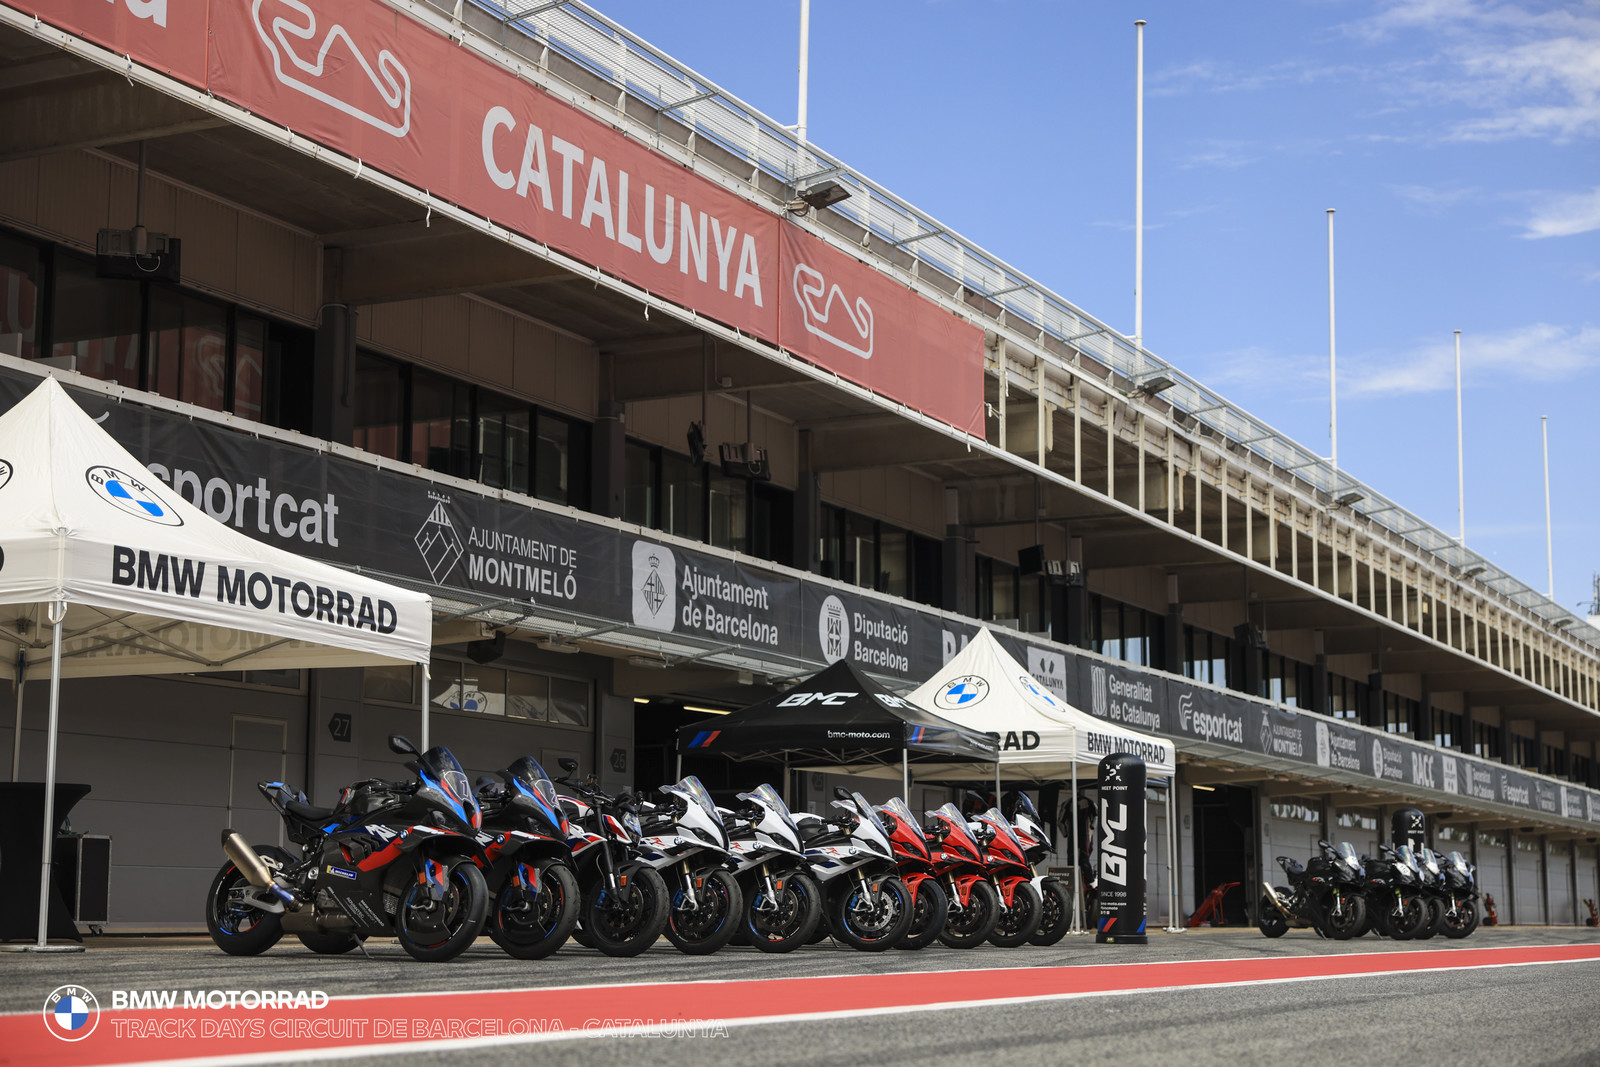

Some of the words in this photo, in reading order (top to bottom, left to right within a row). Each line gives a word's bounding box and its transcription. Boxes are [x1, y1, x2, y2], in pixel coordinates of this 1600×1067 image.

[481, 104, 764, 309] CATALUNYA
[468, 526, 557, 563] AJUNTAMENT
[560, 547, 577, 568] DE
[112, 544, 206, 598] BMW
[216, 565, 398, 635] MOTORRAD
[469, 553, 577, 600] MONTMELÓ
[682, 564, 769, 610] Ajuntament
[682, 599, 702, 629] de
[705, 604, 778, 646] Barcelona
[853, 612, 908, 645] Diputació
[853, 640, 909, 673] Barcelona
[1108, 674, 1153, 703] Generalitat
[333, 717, 350, 737] 27
[1110, 699, 1121, 720] de
[1122, 702, 1160, 732] Catalunya
[1193, 710, 1243, 744] esportcat
[827, 730, 891, 739] bmc-moto.com
[1087, 731, 1112, 755] BMW
[1114, 736, 1166, 764] MOTORRAD
[1411, 750, 1435, 788] RACC
